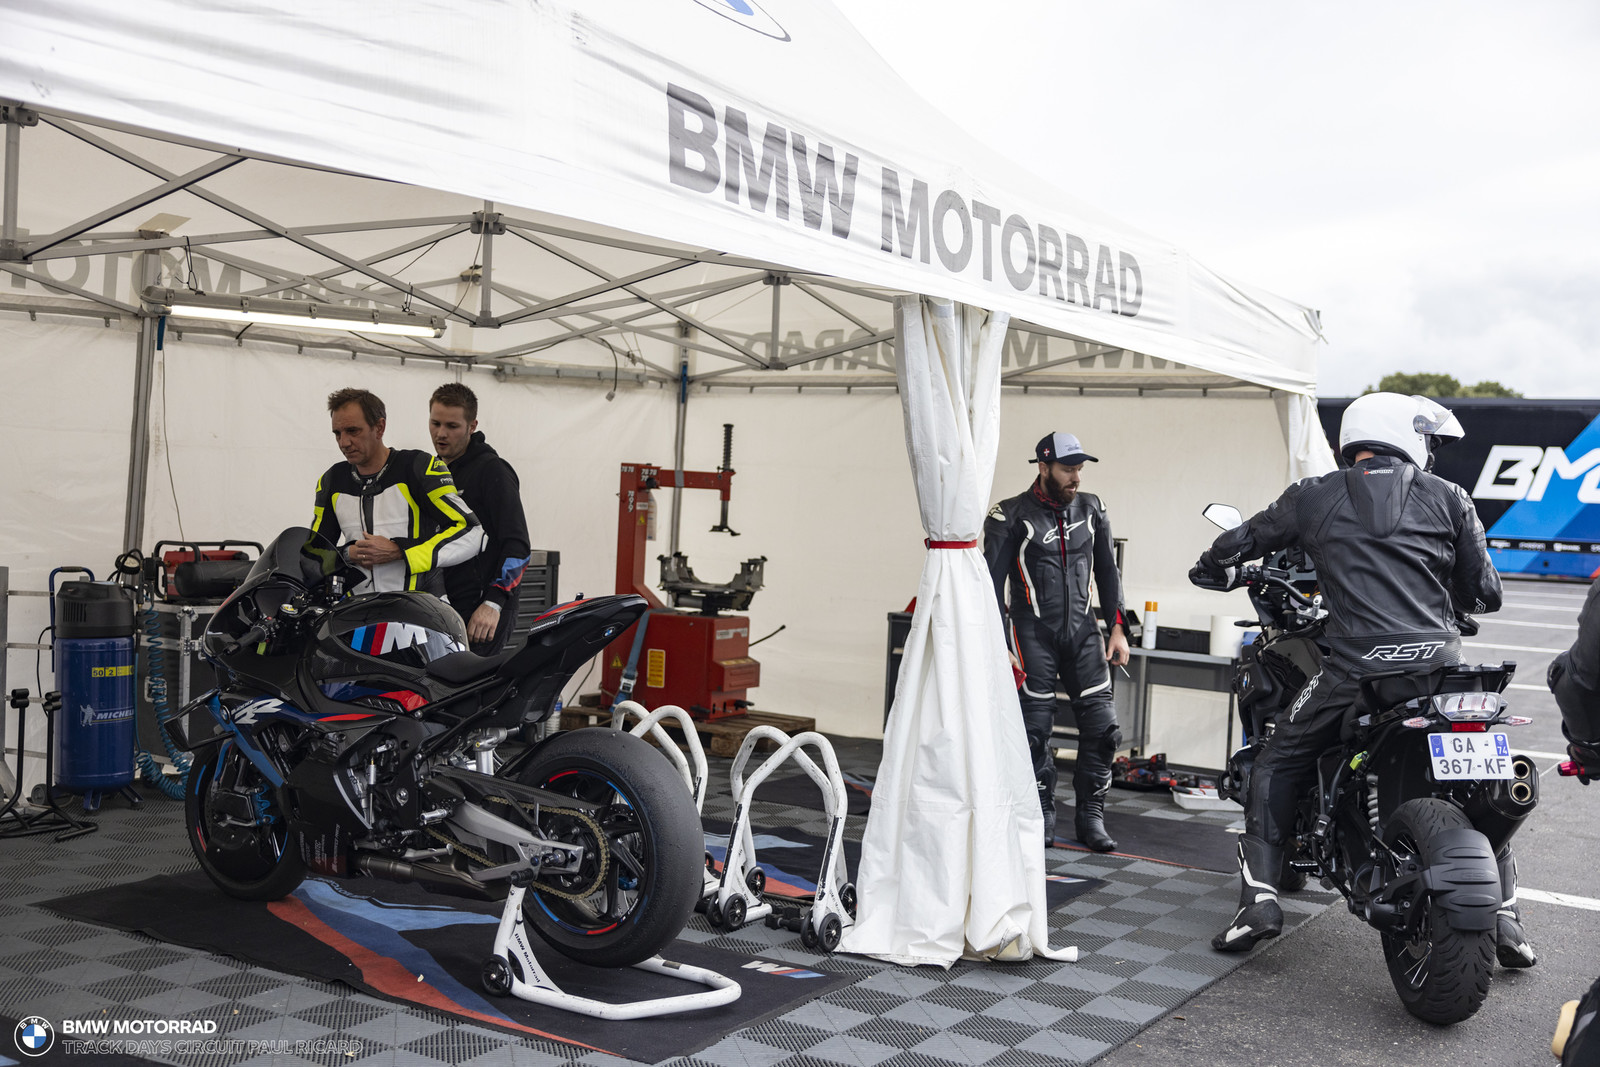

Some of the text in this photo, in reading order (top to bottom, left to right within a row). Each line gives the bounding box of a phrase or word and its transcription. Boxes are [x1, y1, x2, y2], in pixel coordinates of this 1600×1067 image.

[666, 81, 1143, 317] BMW MOTORRAD
[1362, 641, 1446, 661] RST
[1453, 737, 1475, 753] GA
[1497, 746, 1507, 754] 74
[1440, 758, 1506, 775] 367-KF
